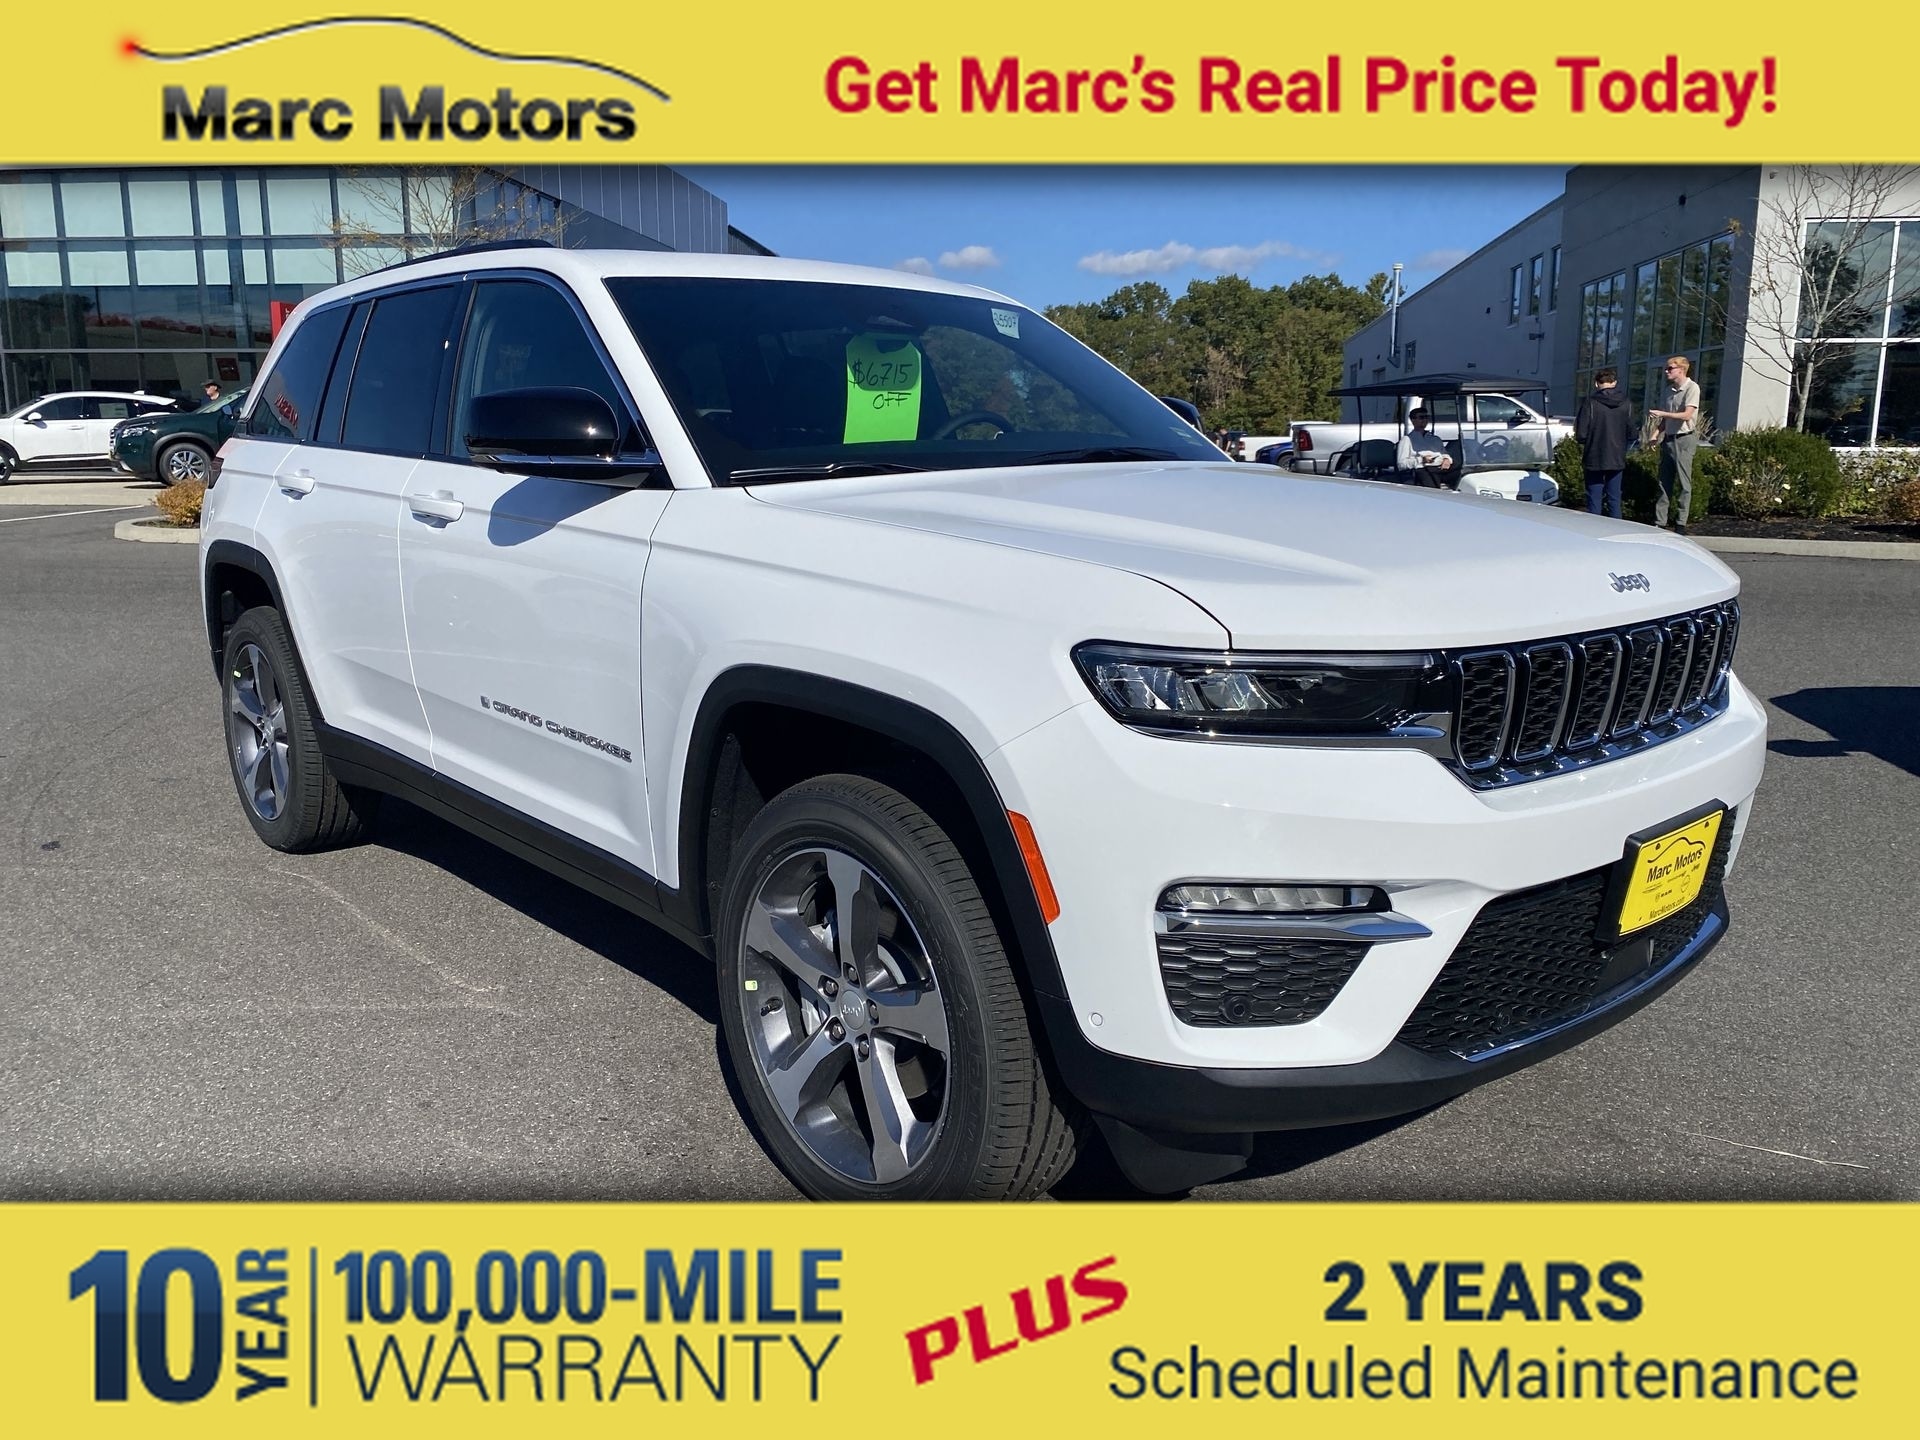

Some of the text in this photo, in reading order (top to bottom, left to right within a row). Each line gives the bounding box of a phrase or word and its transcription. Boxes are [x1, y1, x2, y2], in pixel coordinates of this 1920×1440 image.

[848, 358, 914, 387] $6715
[872, 391, 912, 410] OFF
[1607, 571, 1651, 593] Jeep
[492, 700, 633, 763] GRAND CHEROKEE
[1646, 863, 1672, 883] Marc
[1674, 848, 1703, 872] Motors
